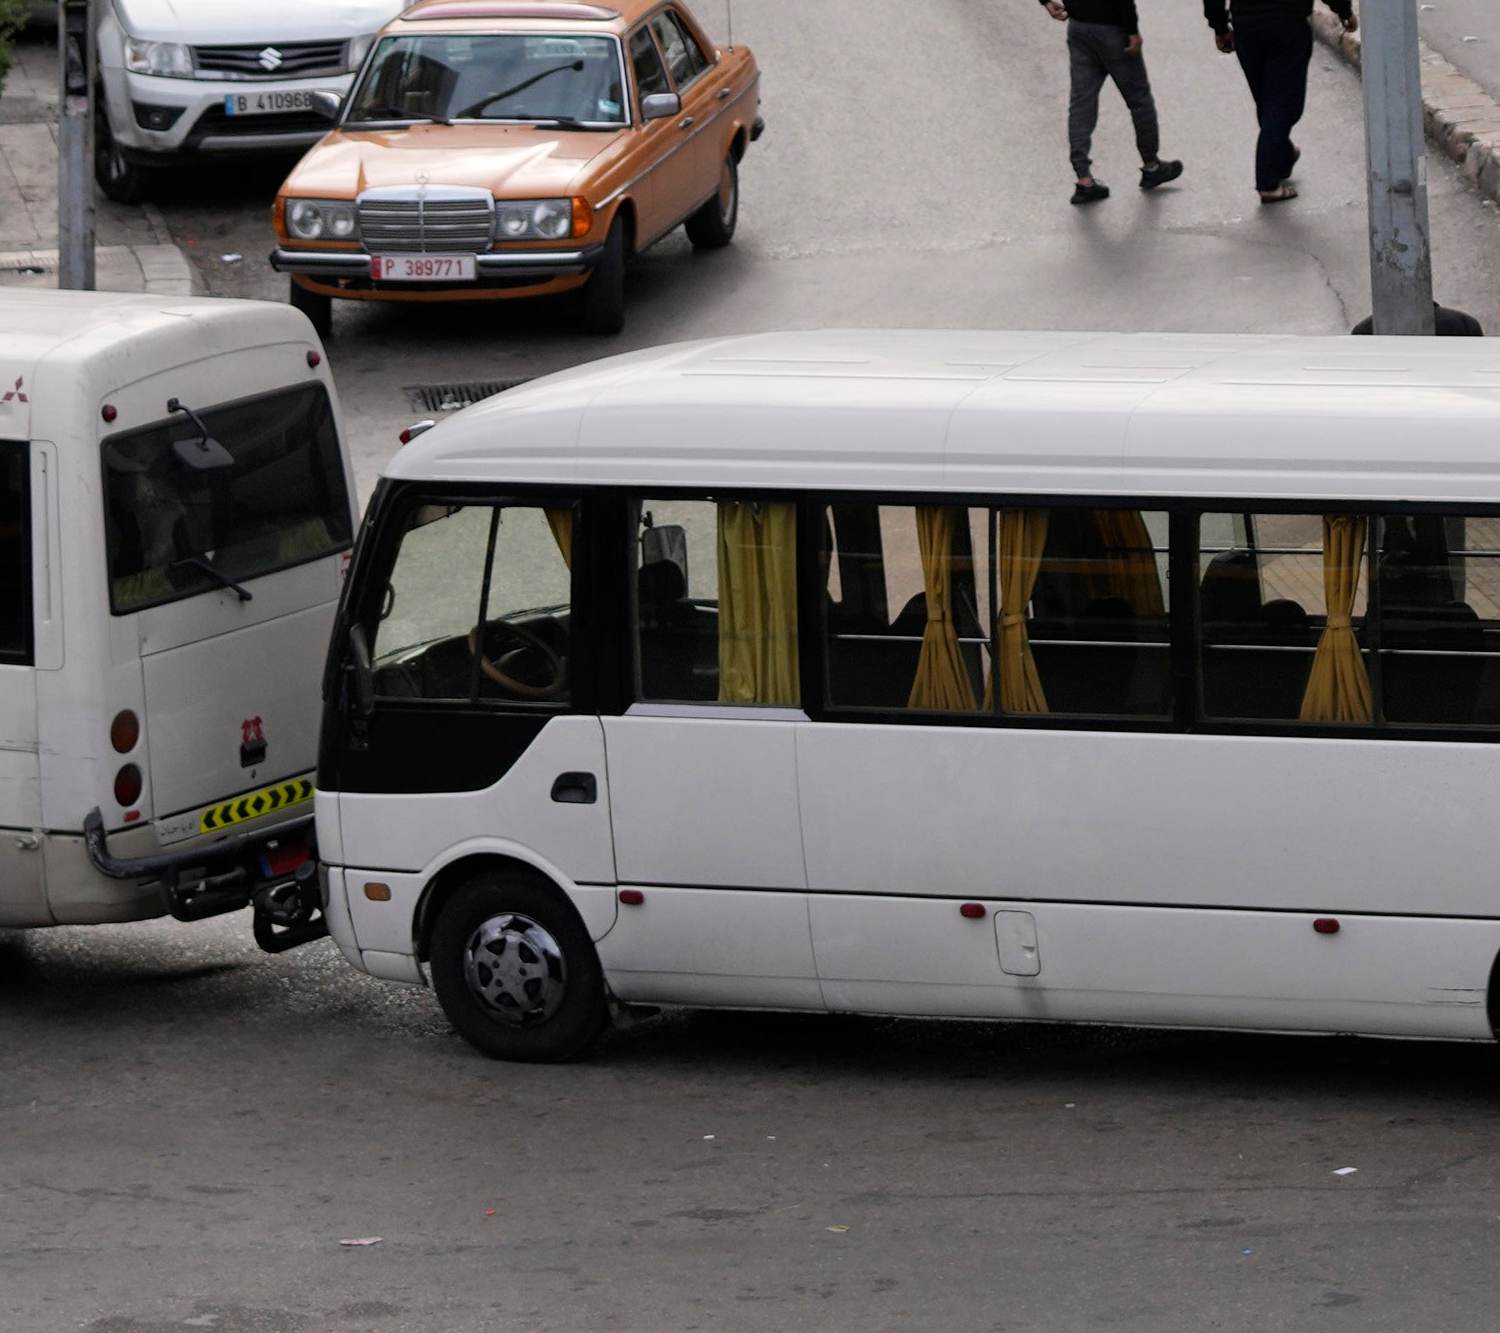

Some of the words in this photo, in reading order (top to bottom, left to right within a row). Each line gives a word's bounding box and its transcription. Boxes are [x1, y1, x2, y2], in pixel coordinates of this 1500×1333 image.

[237, 94, 248, 112] B
[385, 261, 394, 276] P
[405, 259, 463, 277] 389771
